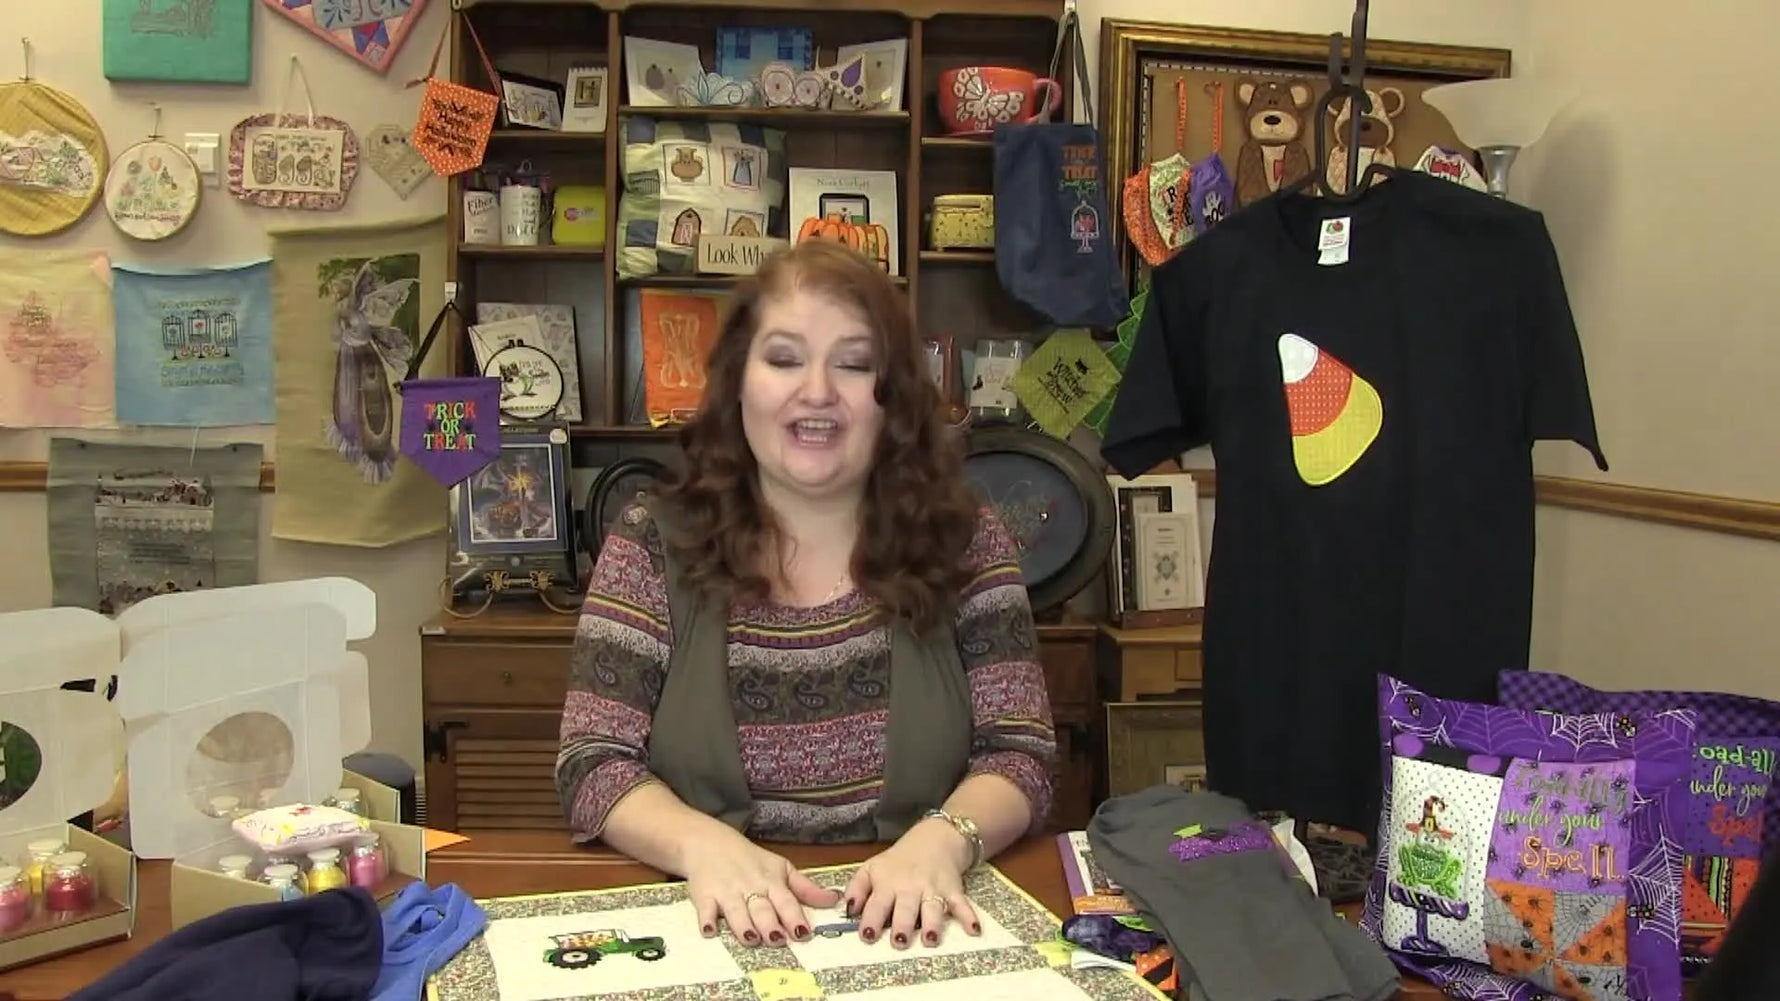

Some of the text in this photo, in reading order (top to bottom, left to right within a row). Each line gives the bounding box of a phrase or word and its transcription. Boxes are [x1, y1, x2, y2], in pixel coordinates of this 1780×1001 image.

[707, 242, 765, 267] Look Wh
[424, 401, 476, 420] TRICK
[441, 418, 460, 434] OR
[423, 432, 476, 450] TREAT
